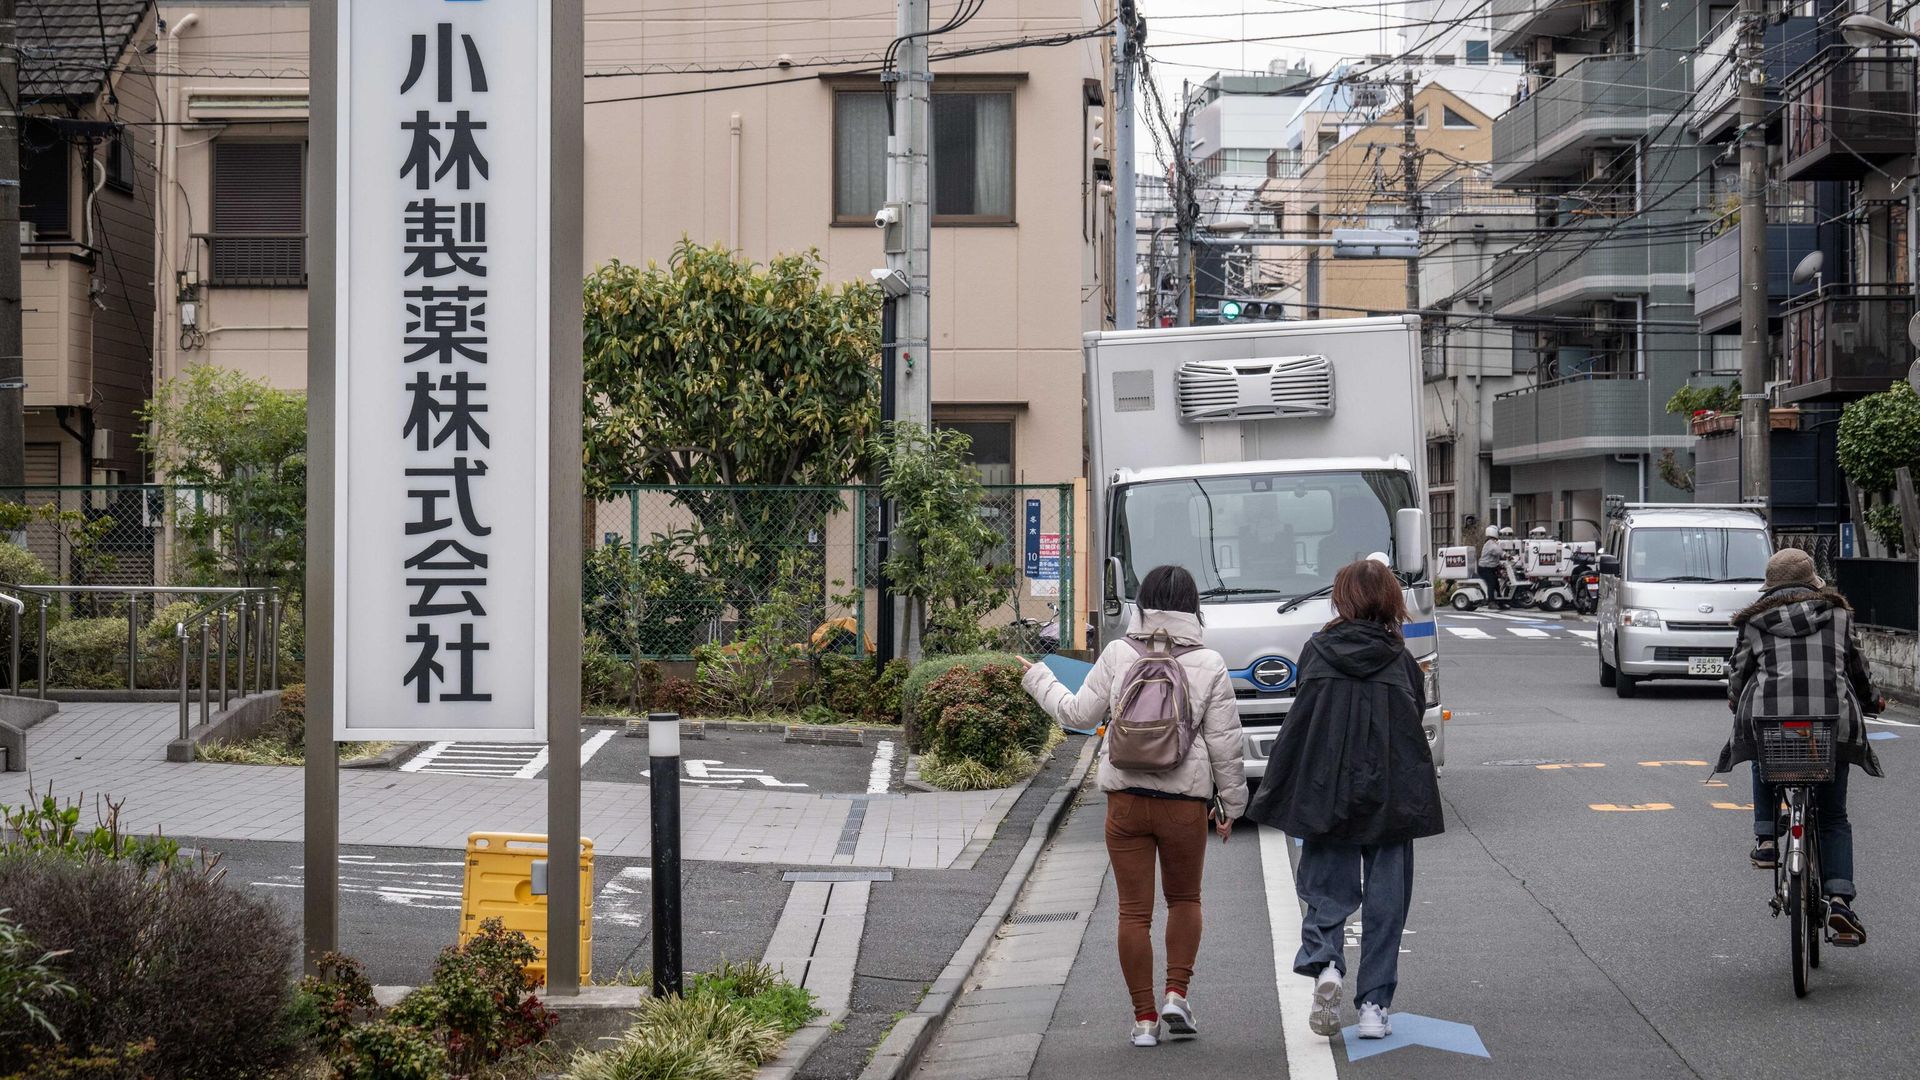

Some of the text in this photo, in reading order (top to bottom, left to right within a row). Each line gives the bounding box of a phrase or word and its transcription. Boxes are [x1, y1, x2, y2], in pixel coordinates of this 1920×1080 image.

[400, 23, 491, 703] 小林製薬株式会社
[1533, 546, 1539, 554] 3
[1027, 552, 1038, 562] 10
[1696, 664, 1721, 673] 55-92
